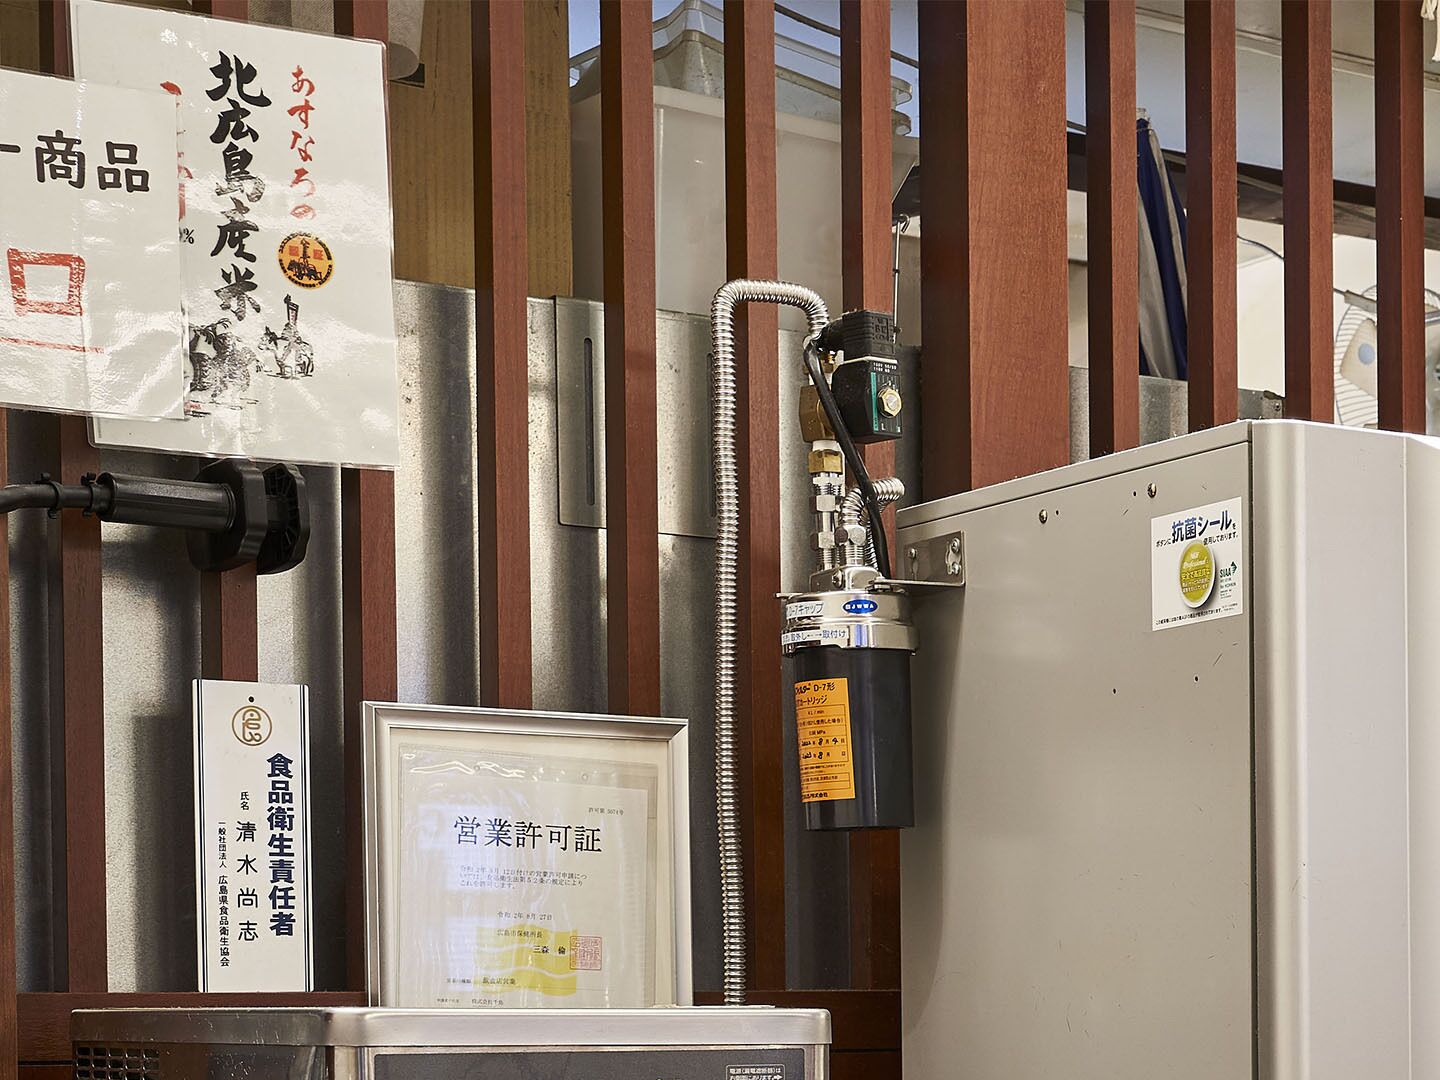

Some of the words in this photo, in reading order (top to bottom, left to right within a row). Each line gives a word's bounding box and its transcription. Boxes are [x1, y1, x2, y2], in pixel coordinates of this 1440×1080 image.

[204, 49, 272, 322] 北広島産米
[287, 64, 318, 221] あすなろの
[218, 821, 227, 869] 一般社団法人
[240, 791, 250, 811] 氏名
[266, 752, 297, 937] 食品衛生責任者
[454, 815, 602, 853] 営業許可証
[218, 875, 230, 967] 広島県食品衛生協会
[236, 820, 259, 942] 清水尚志
